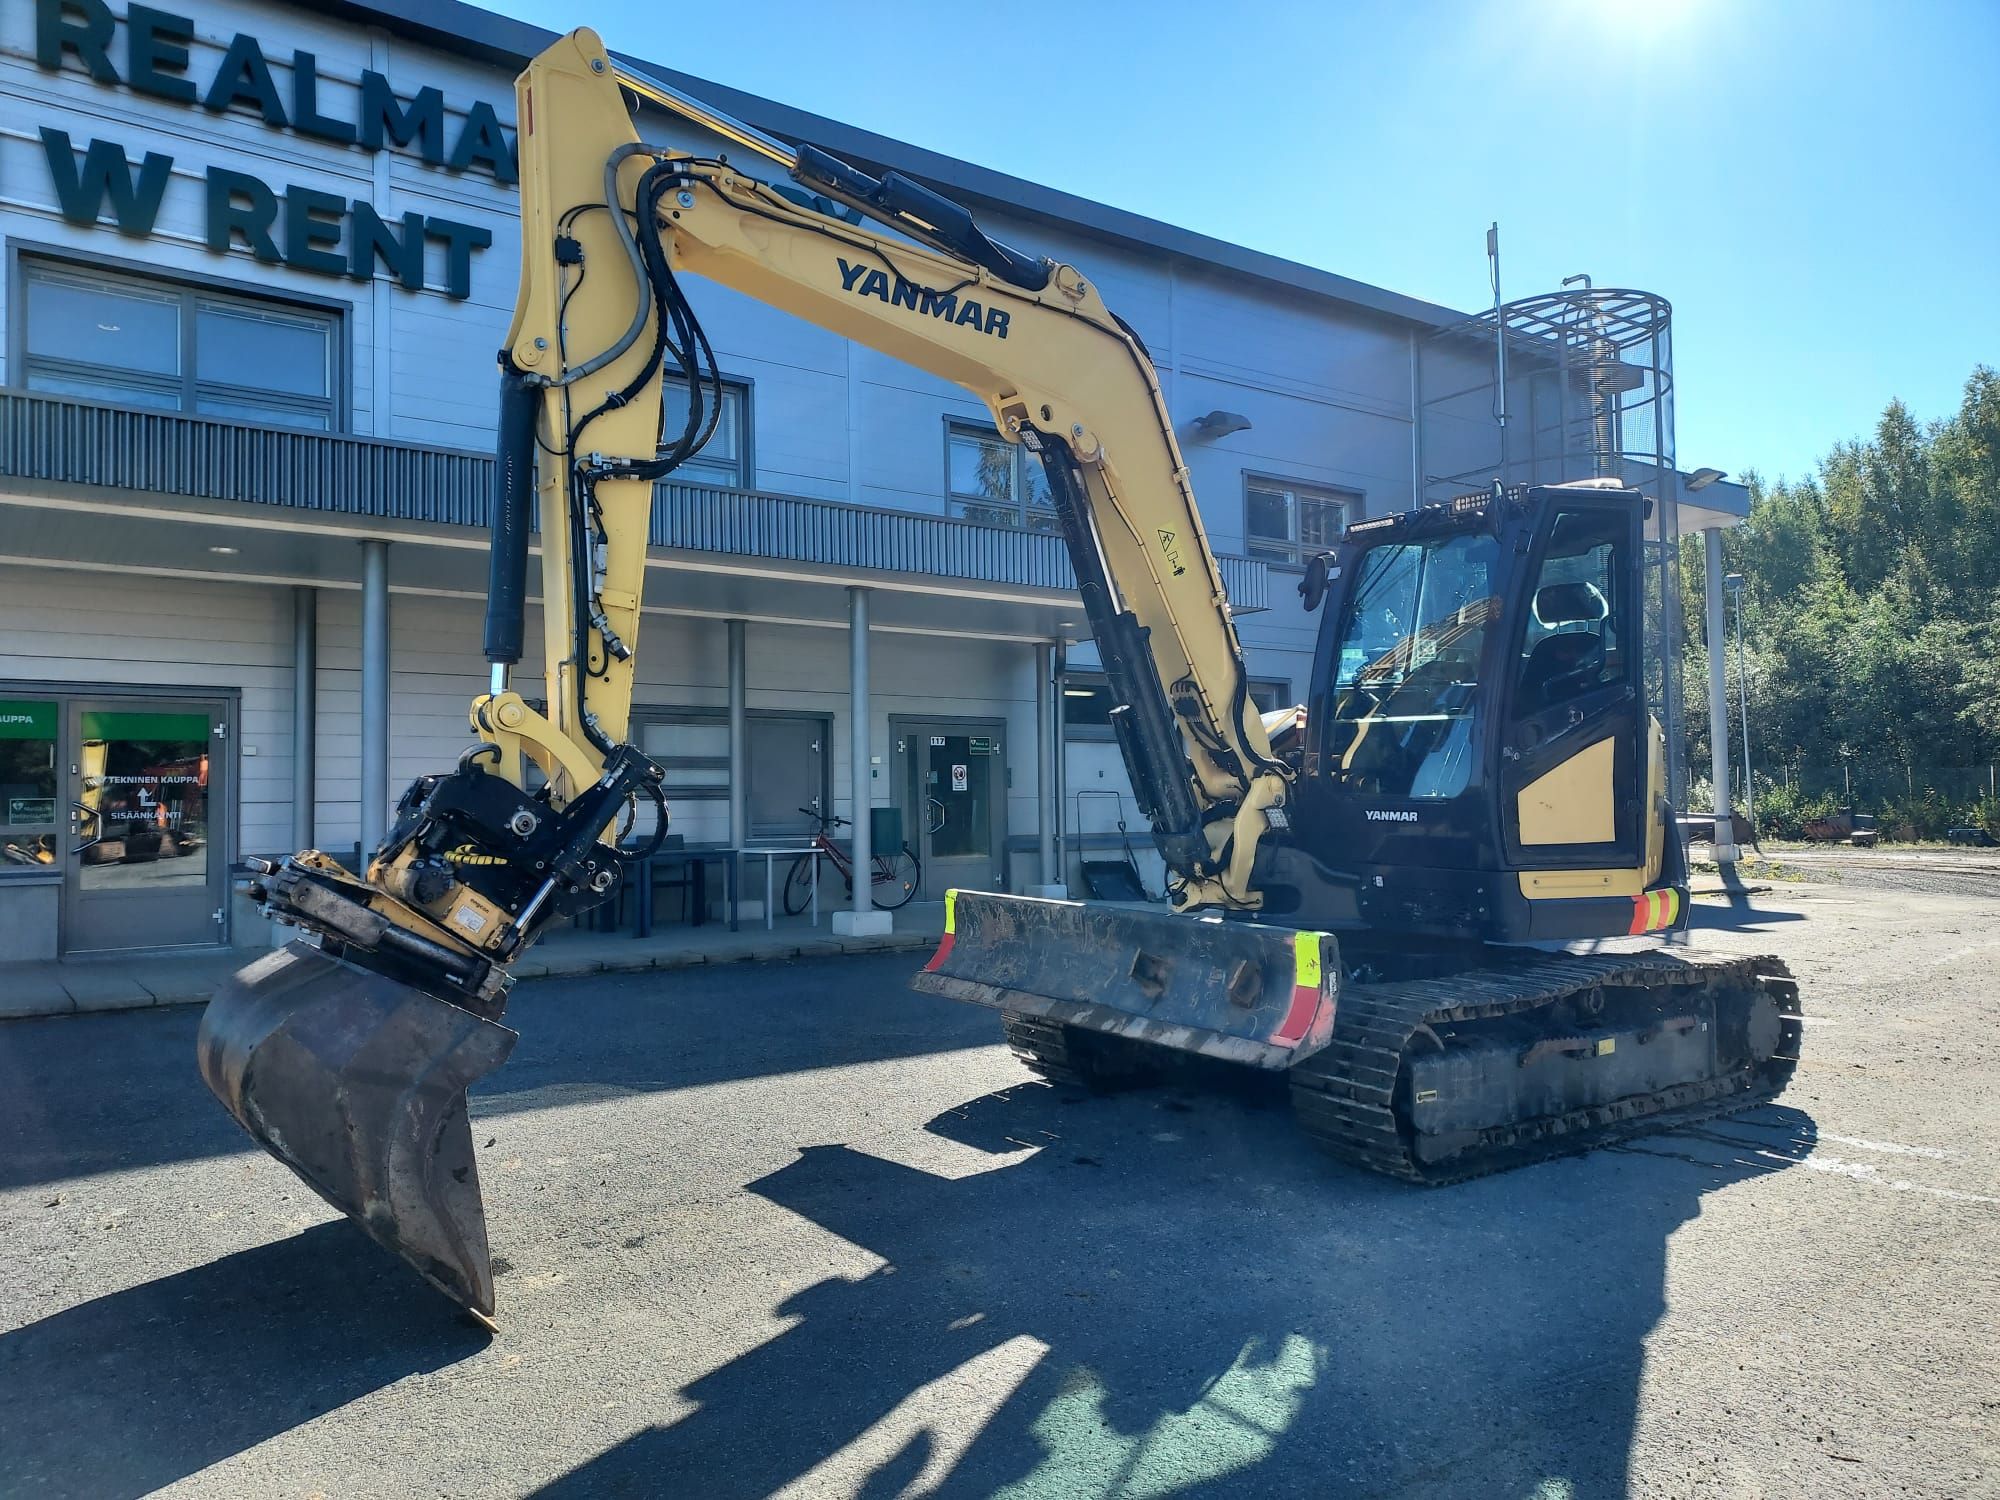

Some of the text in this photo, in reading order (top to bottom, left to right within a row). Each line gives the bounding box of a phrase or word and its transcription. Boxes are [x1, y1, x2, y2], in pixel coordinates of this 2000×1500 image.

[36, 0, 519, 185] REALMA
[38, 125, 492, 300] W RENT
[837, 258, 1010, 339] YANMAR
[109, 776, 199, 784] TEKNINEN KAUPPA
[1366, 810, 1418, 822] YANMAR
